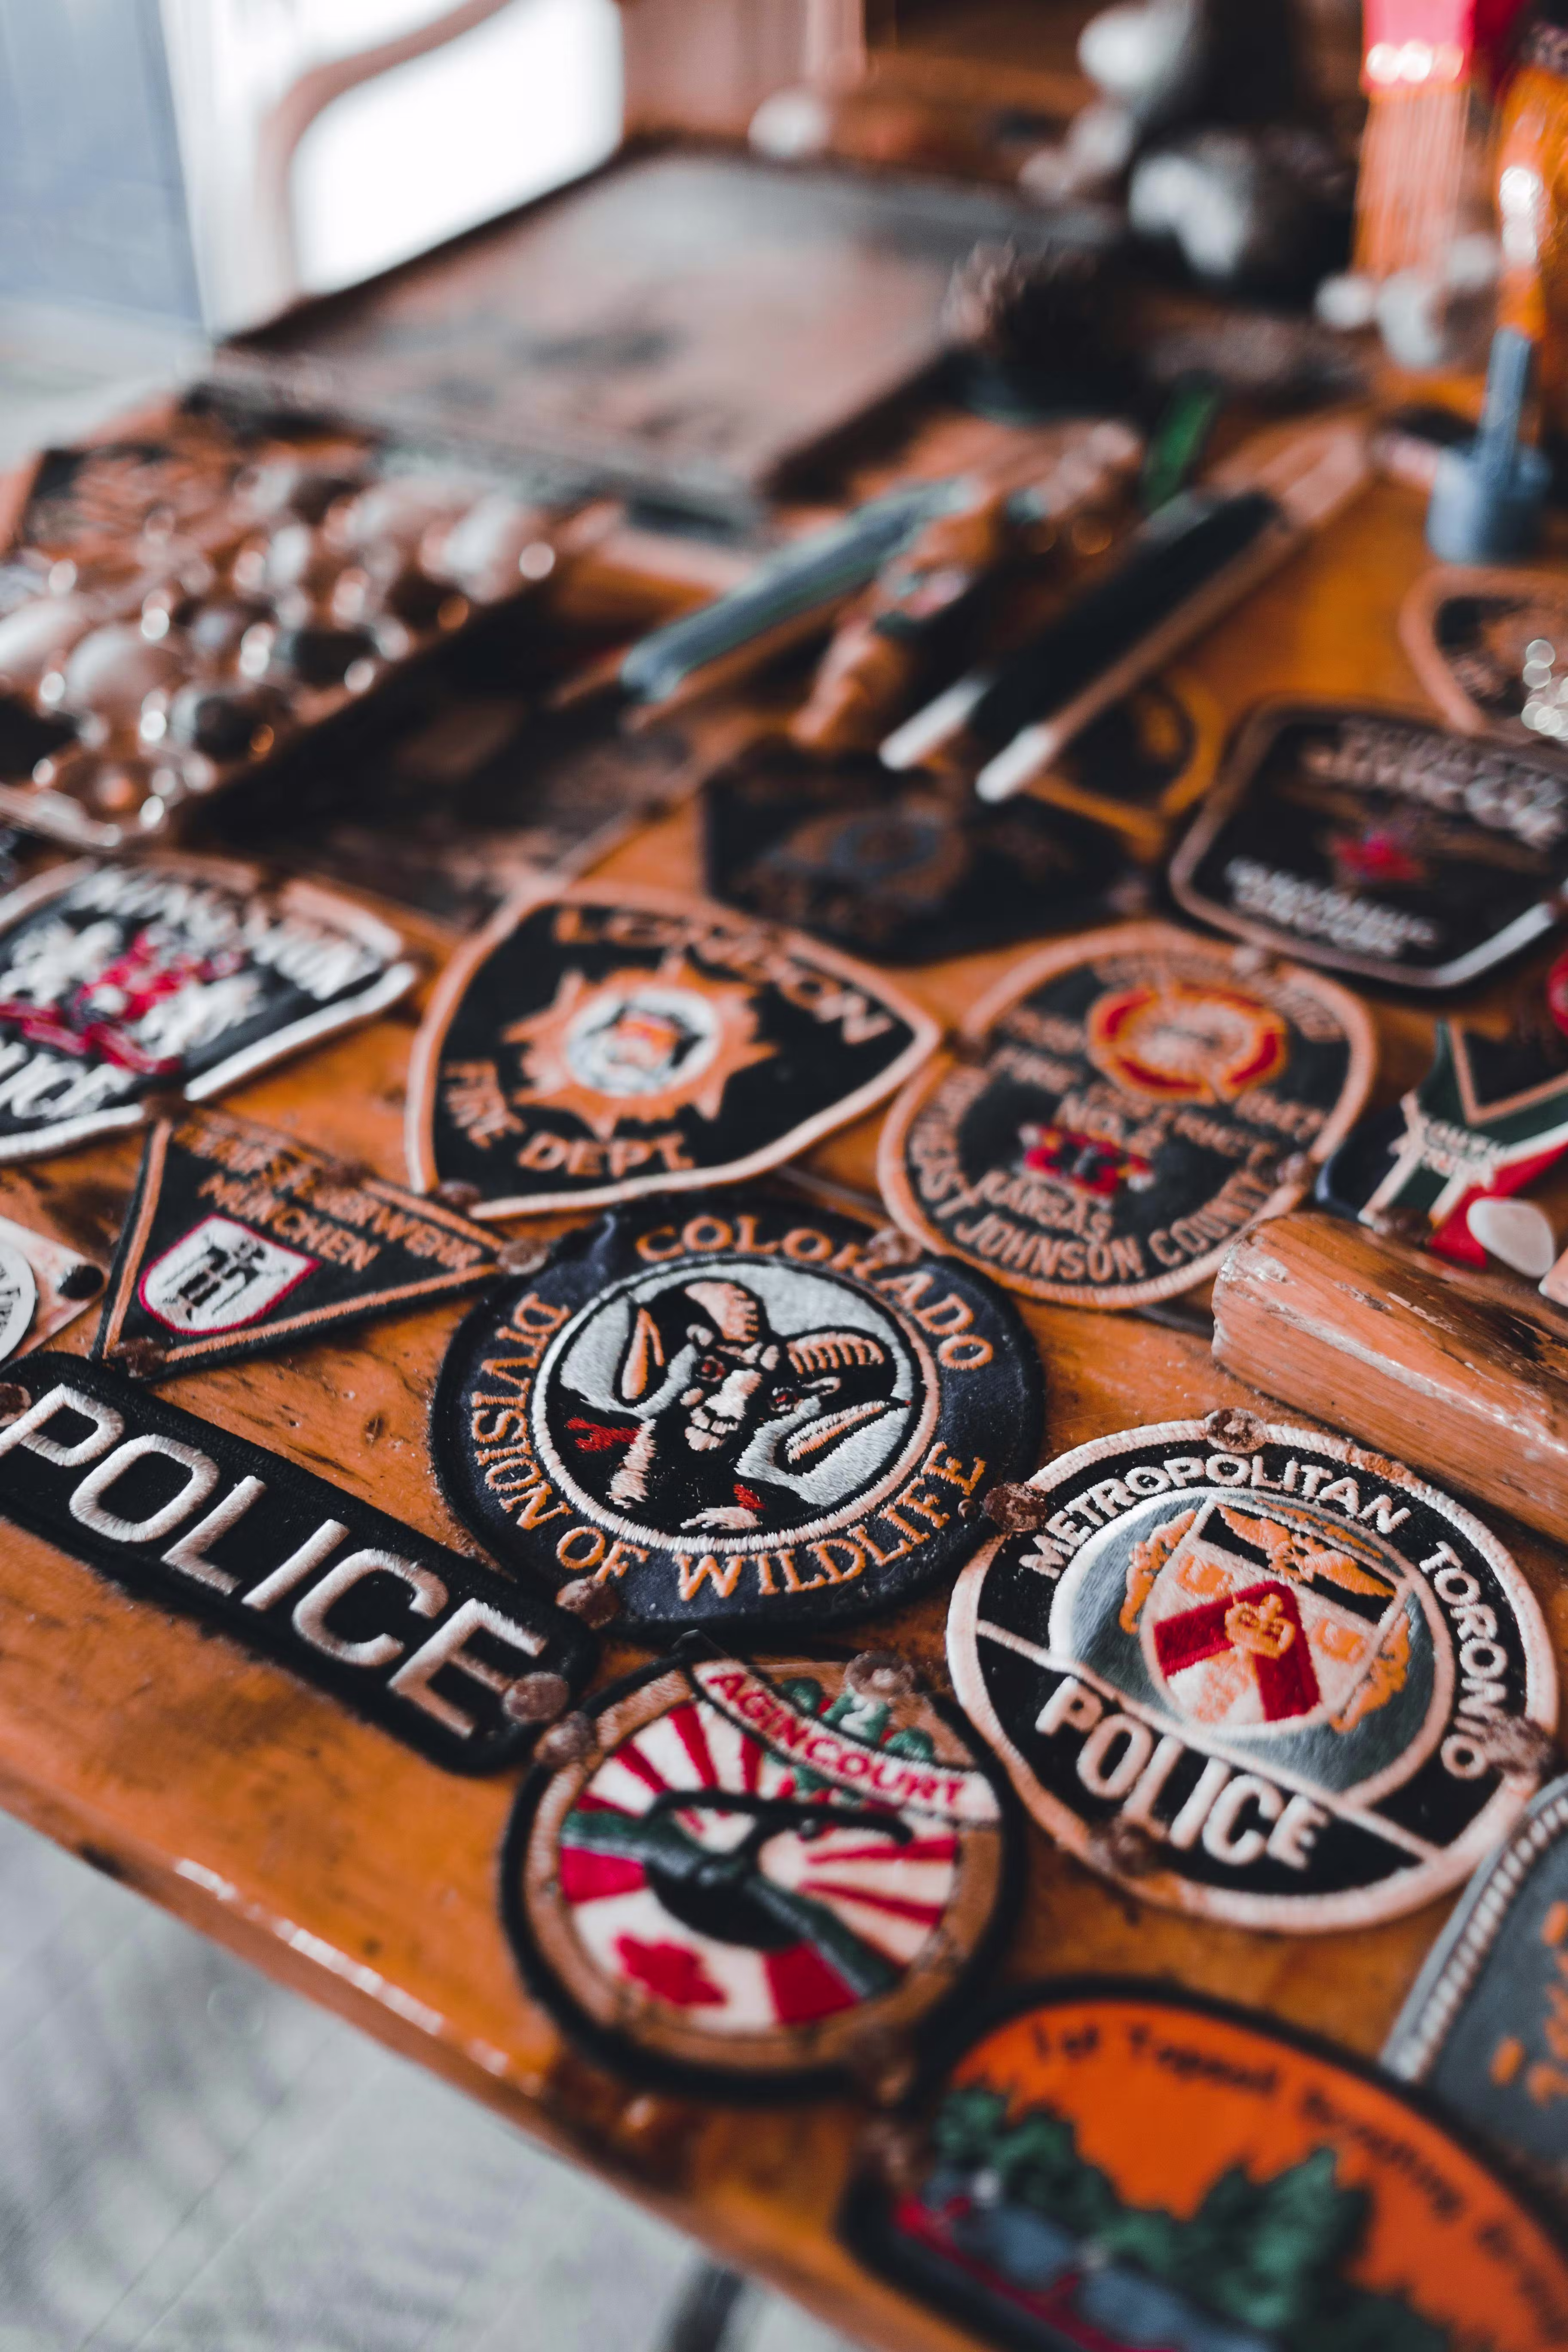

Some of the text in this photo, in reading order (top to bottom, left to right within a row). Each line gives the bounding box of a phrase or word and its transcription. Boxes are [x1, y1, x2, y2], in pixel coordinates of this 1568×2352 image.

[444, 1060, 526, 1149] FIRE
[953, 1212, 1147, 1283] JOHNSON
[971, 1169, 1114, 1241] KANSAS
[470, 1292, 987, 1602] DIVISION OF WILDLIFE
[0, 1383, 548, 1739] POLICE
[1018, 1453, 1412, 1580] METROPOLITAN
[706, 1672, 965, 1804] AGINCOURT
[1034, 1675, 1331, 1872] POLICE
